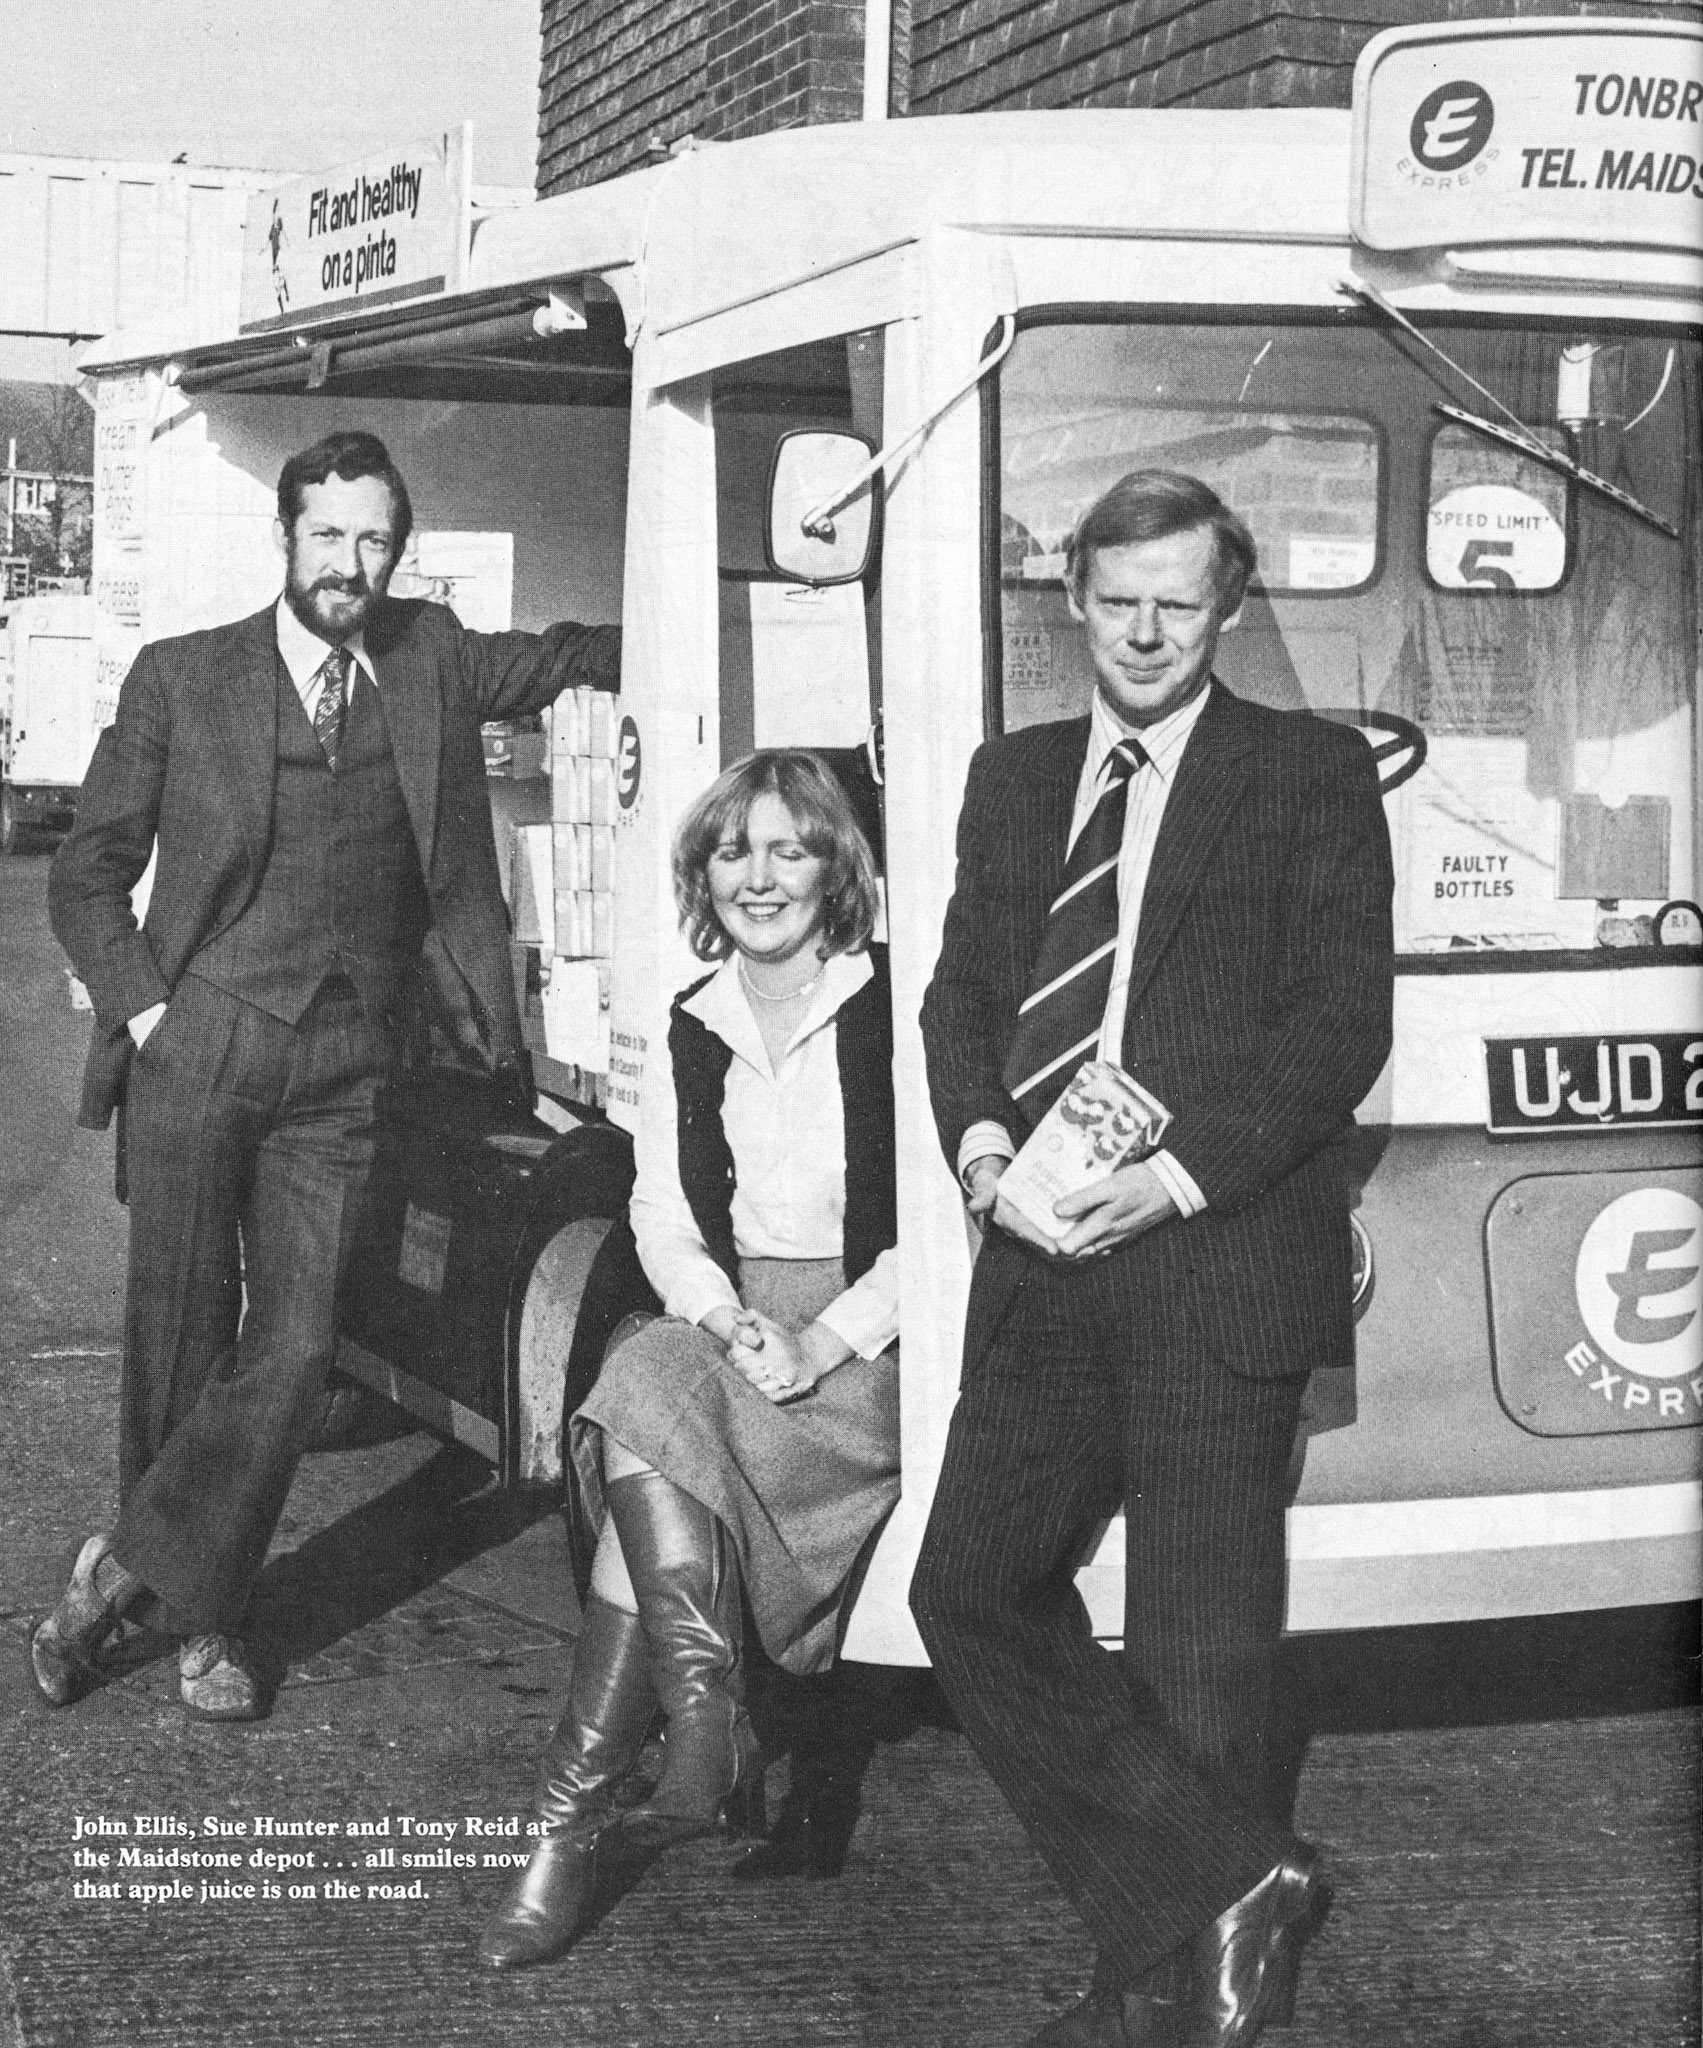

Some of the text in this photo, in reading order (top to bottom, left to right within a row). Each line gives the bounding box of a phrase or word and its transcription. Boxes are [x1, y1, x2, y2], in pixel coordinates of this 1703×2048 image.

[1575, 74, 1703, 122] TONBR
[1396, 148, 1501, 191] EXPRESS
[308, 161, 422, 238] Fit and healthy
[322, 228, 396, 294] on a pinta
[1433, 511, 1541, 530] SPEED LIMIT
[1458, 539, 1516, 588] 5
[1441, 855, 1509, 874] FAULTY
[1433, 879, 1515, 899] BOTTLES
